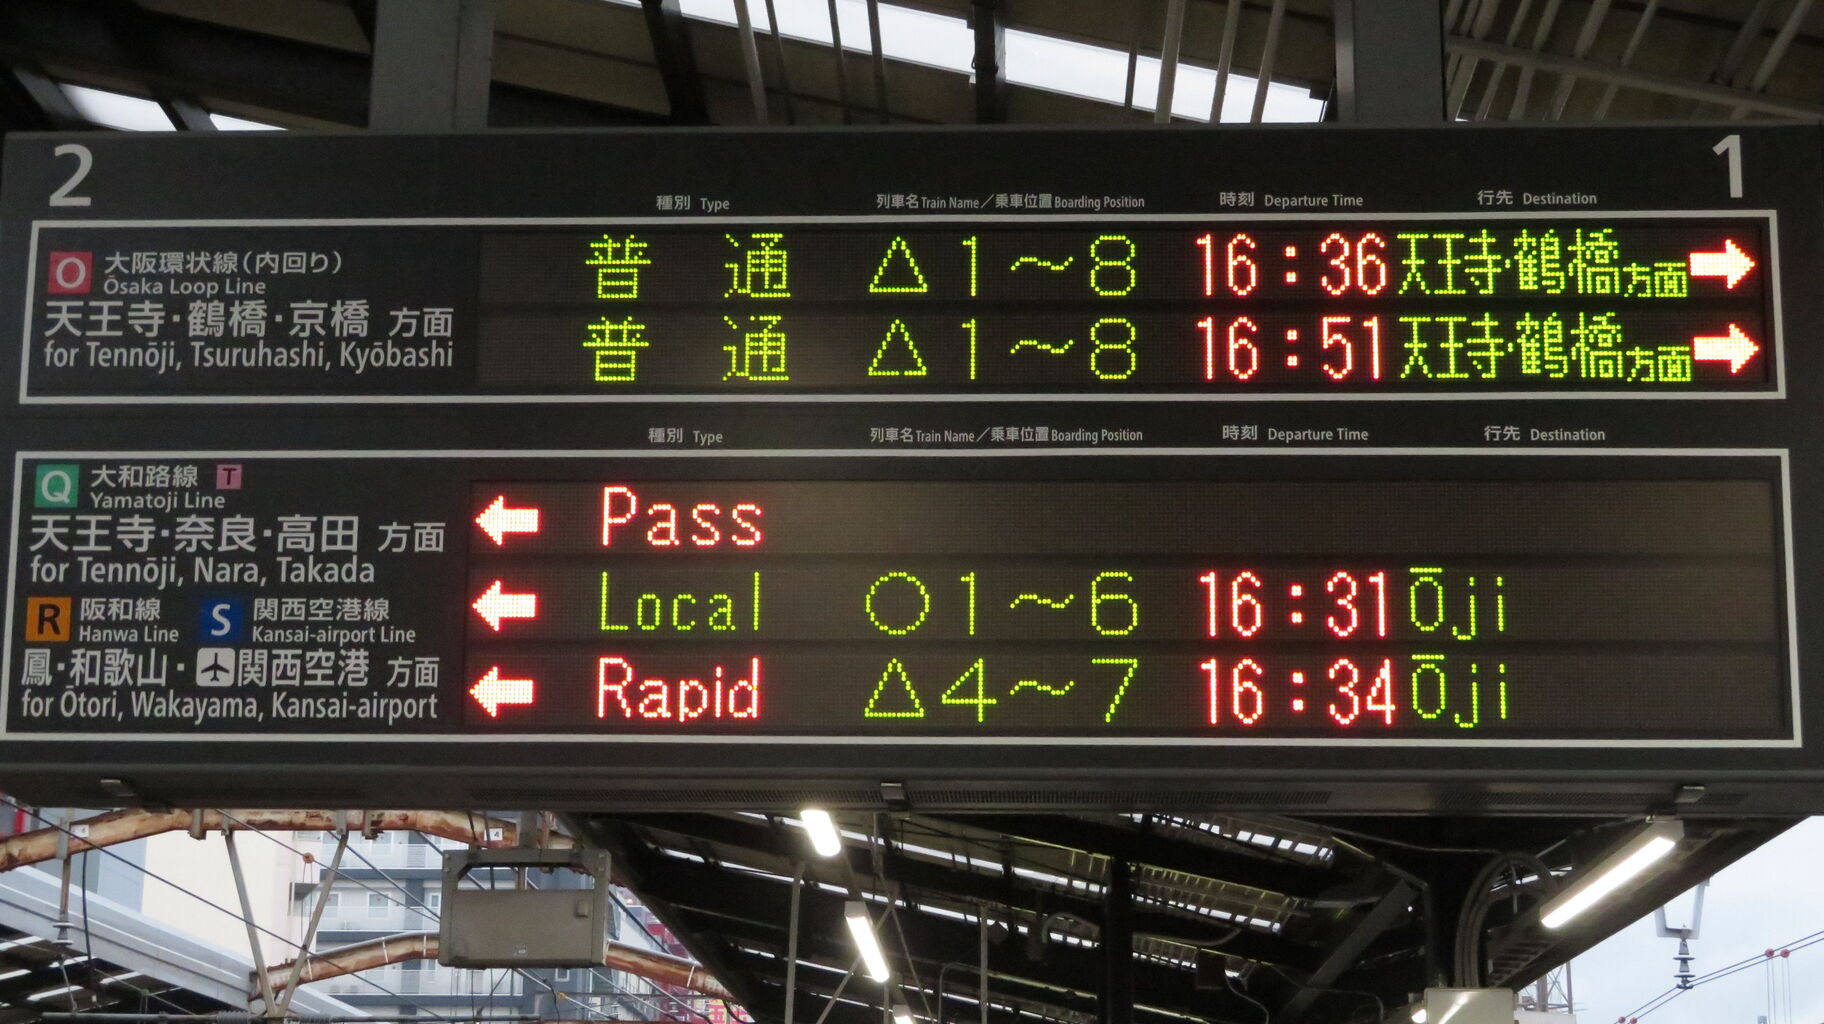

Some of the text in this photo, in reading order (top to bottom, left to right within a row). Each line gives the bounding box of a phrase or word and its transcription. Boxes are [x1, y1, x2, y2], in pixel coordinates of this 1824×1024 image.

[48, 143, 93, 207] 2
[1711, 134, 1743, 199] 1
[656, 195, 730, 213] 種別 Type
[876, 194, 920, 209] 列車名
[922, 197, 947, 209] Train
[949, 197, 980, 209] Name
[994, 194, 1053, 208] 乗車位置
[1054, 196, 1101, 211] Boarding
[1103, 196, 1145, 208] Position
[1219, 192, 1364, 210] 時刻 Departure Time
[1477, 190, 1598, 206] 行先 Destination
[55, 257, 87, 289] O
[169, 277, 219, 298] Loop
[225, 277, 267, 295] Line
[388, 307, 454, 338] 方面
[44, 341, 80, 368] for
[190, 341, 331, 372] Tsuruhashi,
[648, 428, 723, 446] 種別 Type
[870, 427, 914, 443] 列車名
[916, 430, 942, 443] Train
[944, 430, 975, 443] Name
[990, 426, 1049, 442] 乗車位置
[1051, 429, 1099, 445] Boarding
[1101, 428, 1143, 441] Position
[1222, 425, 1369, 443] 時刻 Departure Time
[1483, 425, 1606, 442] 行先 Destination
[41, 470, 72, 504] Q
[90, 465, 199, 489] 大和路線
[222, 468, 238, 485] T
[90, 492, 226, 513] Yamatoji Line
[602, 485, 762, 547] Pass
[378, 522, 446, 553] 方面
[30, 557, 70, 583] for
[194, 557, 268, 587] Nara,
[276, 557, 375, 583] Takada
[79, 598, 161, 621] 阪和線
[253, 598, 390, 621] 関西空港線
[600, 571, 760, 631] Local
[37, 604, 62, 635] R
[210, 603, 232, 637] S
[79, 626, 179, 643] Hanwa Line
[251, 626, 417, 647] Kansai-airport Line
[237, 649, 370, 687] 関西空港
[386, 657, 440, 688] 方面
[598, 657, 759, 723] Rapid
[21, 690, 57, 719] for
[130, 691, 264, 725] Wakayama,
[270, 691, 438, 725] Kansai-airport
